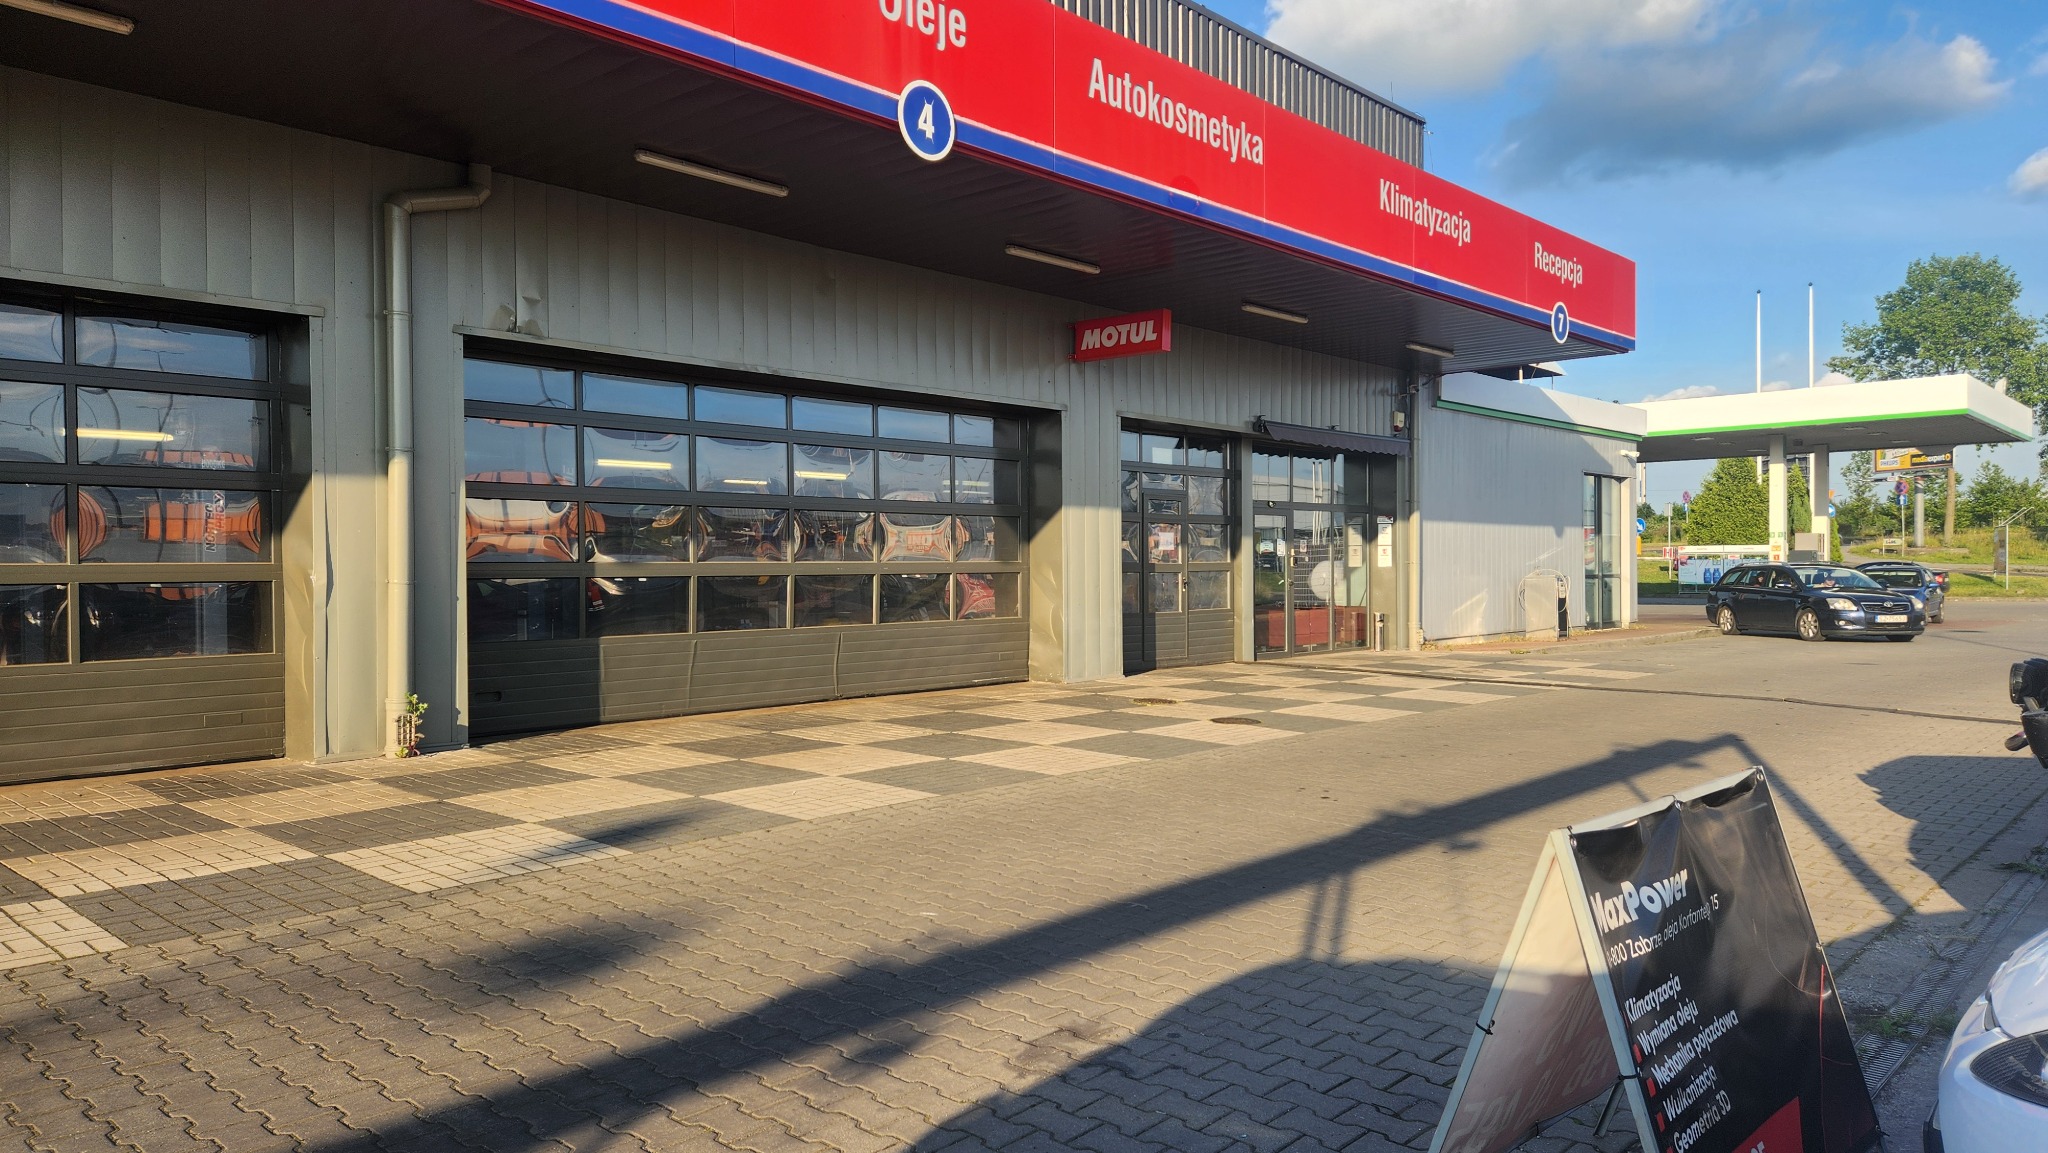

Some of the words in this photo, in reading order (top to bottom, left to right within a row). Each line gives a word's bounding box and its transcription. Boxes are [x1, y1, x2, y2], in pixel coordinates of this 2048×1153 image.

[917, 101, 935, 141] 4
[1088, 57, 1264, 165] Autokosmetyka
[1379, 178, 1471, 247] Klimatyzacja
[1534, 241, 1583, 288] Recepcja
[1080, 319, 1158, 351] MOTUL
[1557, 312, 1565, 333] 7
[1590, 868, 1688, 936] MaxPower
[1710, 893, 1719, 911] 15
[1624, 972, 1682, 1025] Klimatyzacja
[1636, 1014, 1678, 1056] Wymiana
[1676, 997, 1699, 1027] oleju
[1651, 1040, 1696, 1089] Mechanika
[1692, 1009, 1739, 1059] pojazdowa
[1662, 1063, 1718, 1122] Wulkanizacja
[1673, 1106, 1721, 1153] Geometria
[1715, 1089, 1732, 1117] 3D
